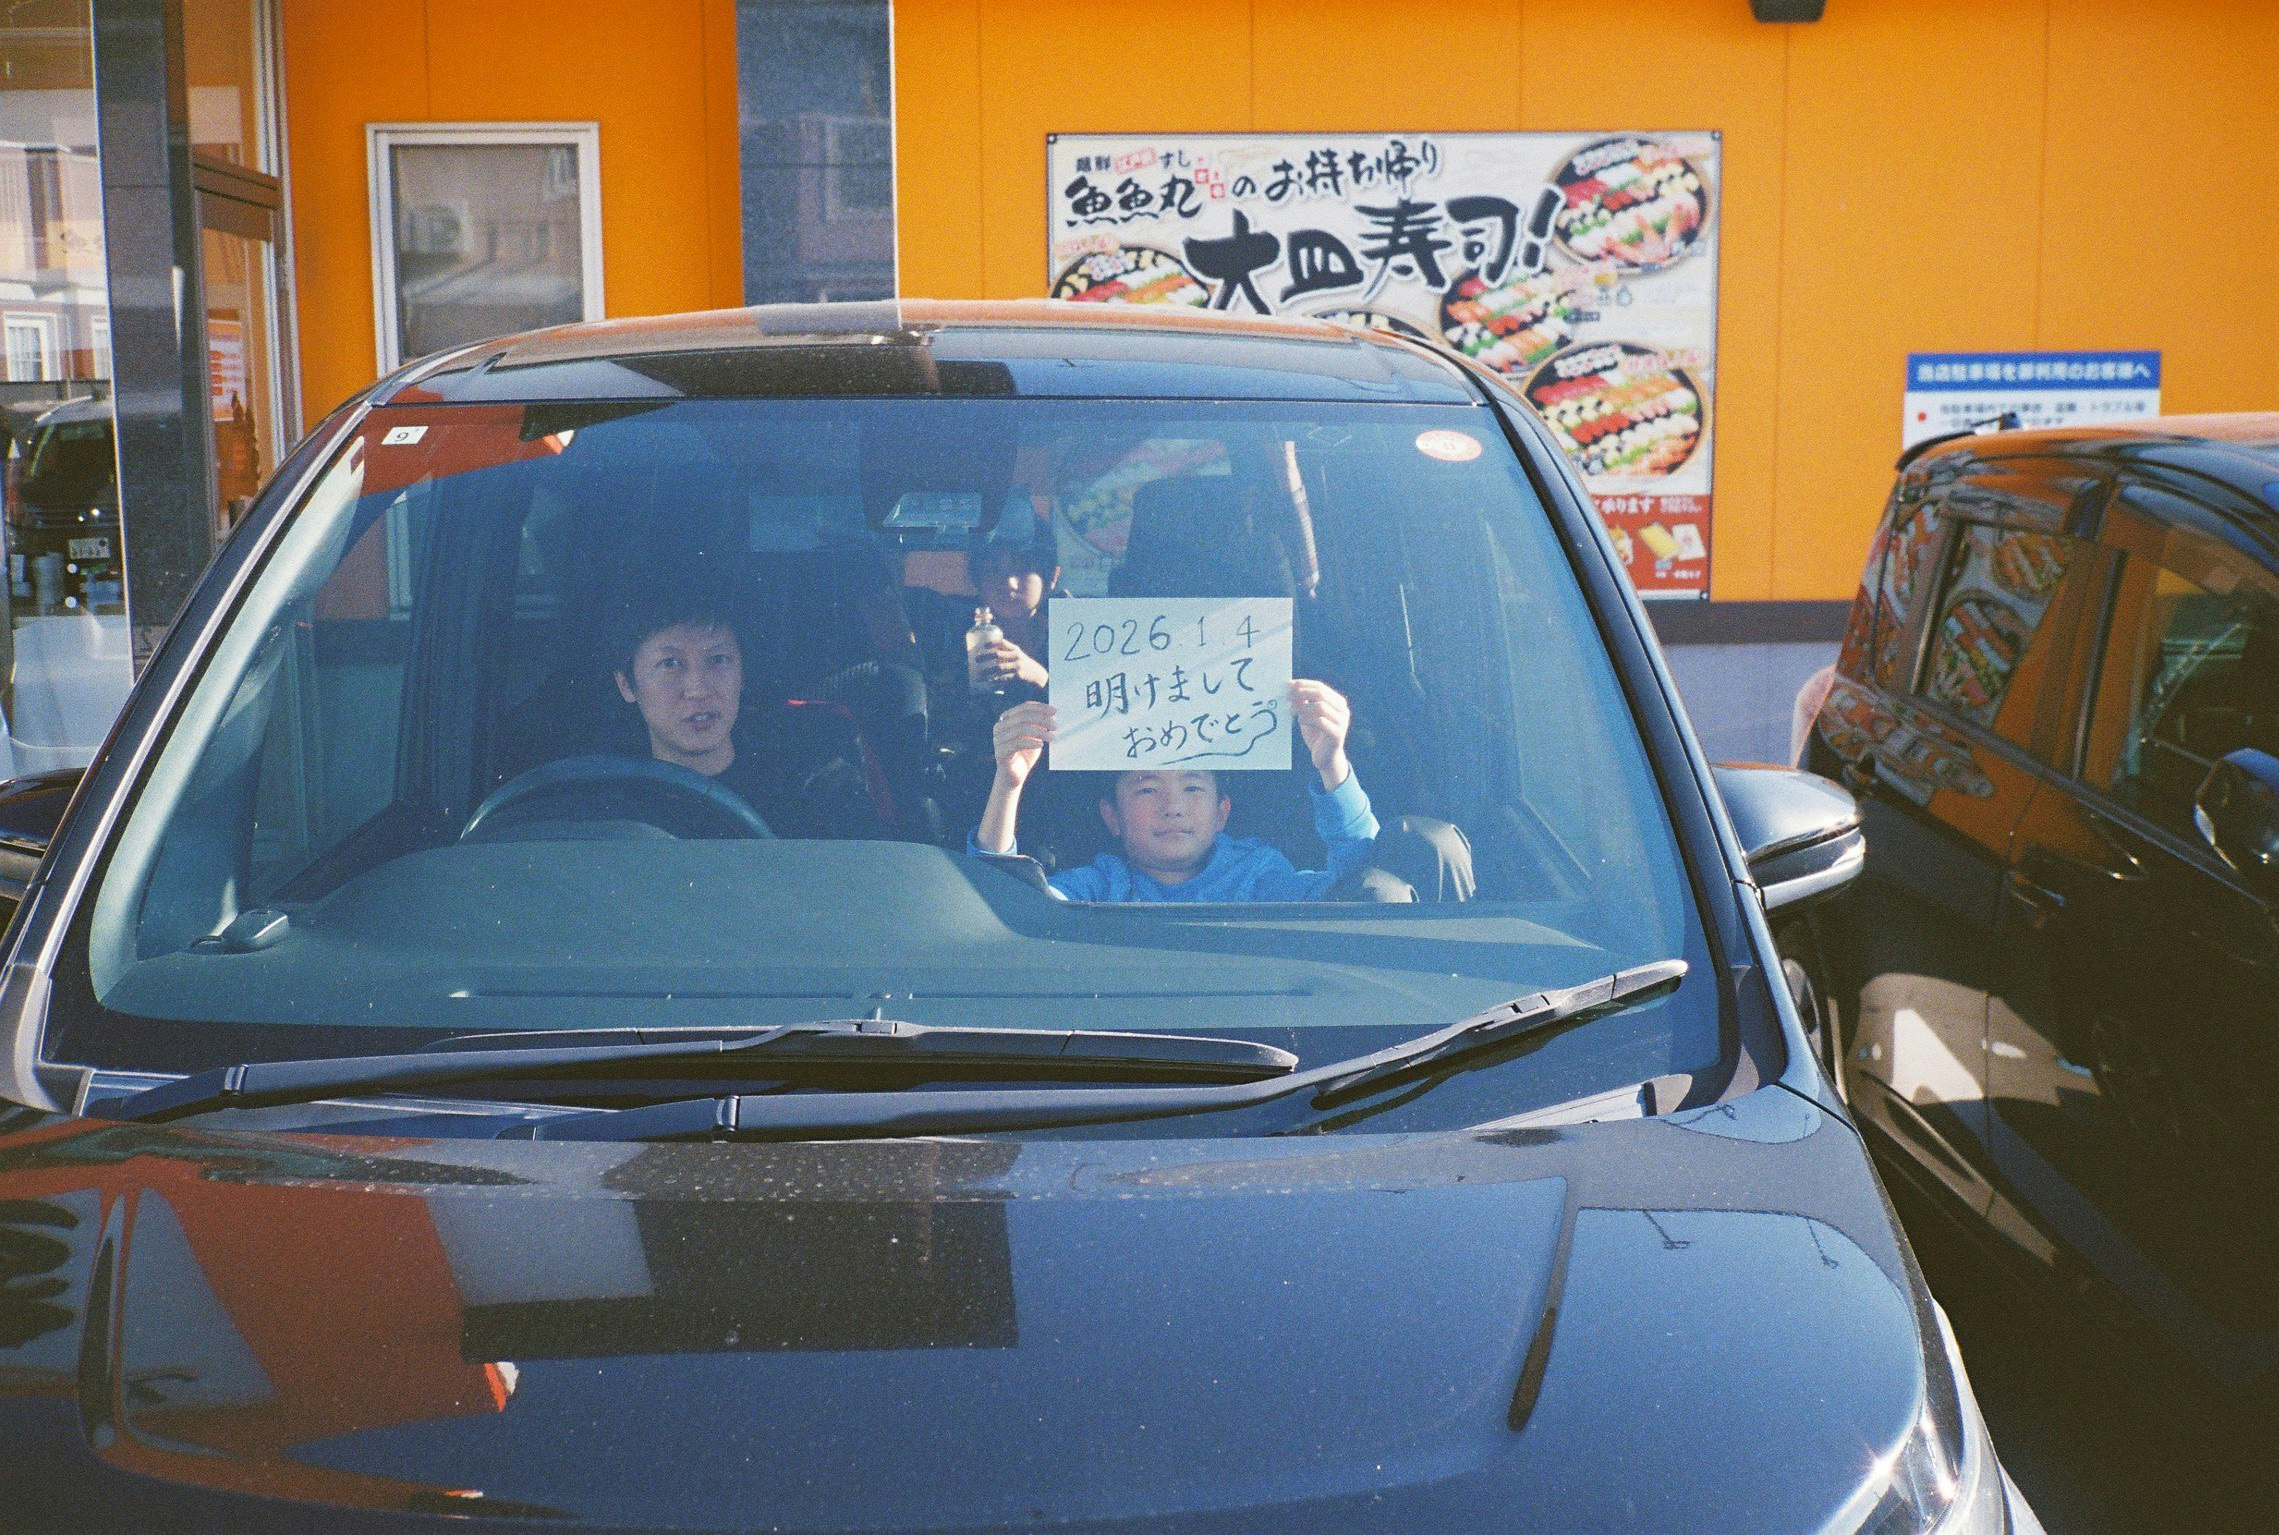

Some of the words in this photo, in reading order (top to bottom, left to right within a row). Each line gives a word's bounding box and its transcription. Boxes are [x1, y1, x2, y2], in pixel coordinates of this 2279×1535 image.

[1065, 174, 1202, 226] 魚魚丸
[1085, 657, 1255, 719] 明けまして
[1122, 699, 1278, 766] おめでとう
